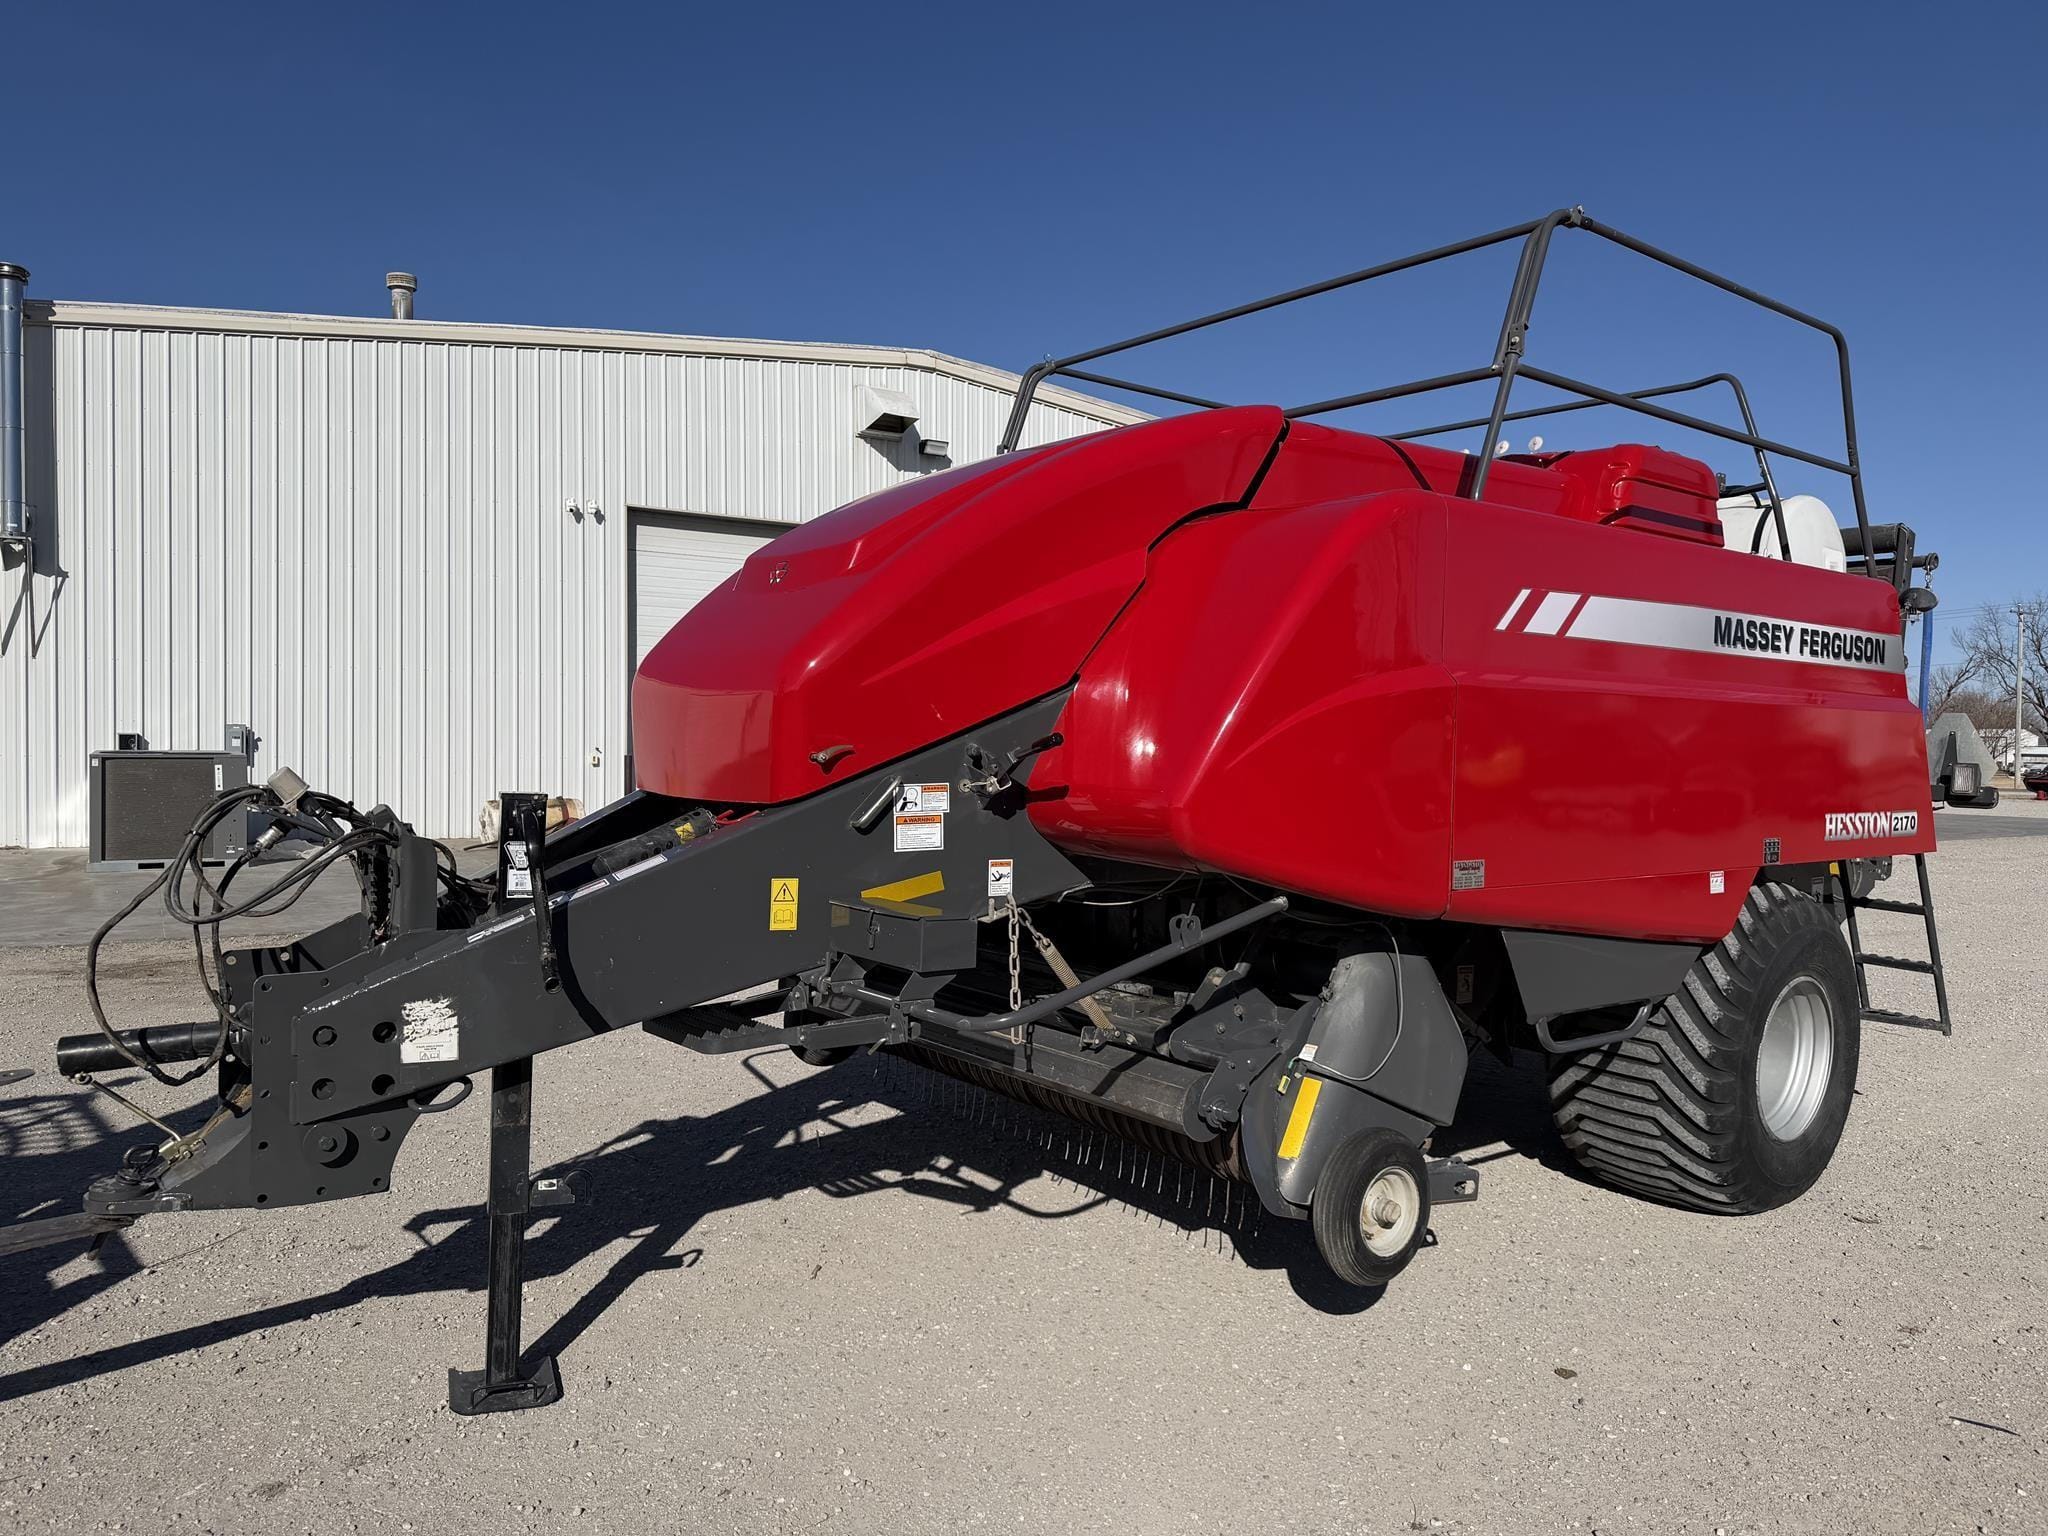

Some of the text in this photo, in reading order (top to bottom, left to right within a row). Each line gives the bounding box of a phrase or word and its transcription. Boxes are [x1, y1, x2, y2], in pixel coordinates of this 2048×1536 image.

[1713, 615, 1886, 665] MASSEY FERGUSON
[1824, 811, 1916, 841] HESSTON 2170
